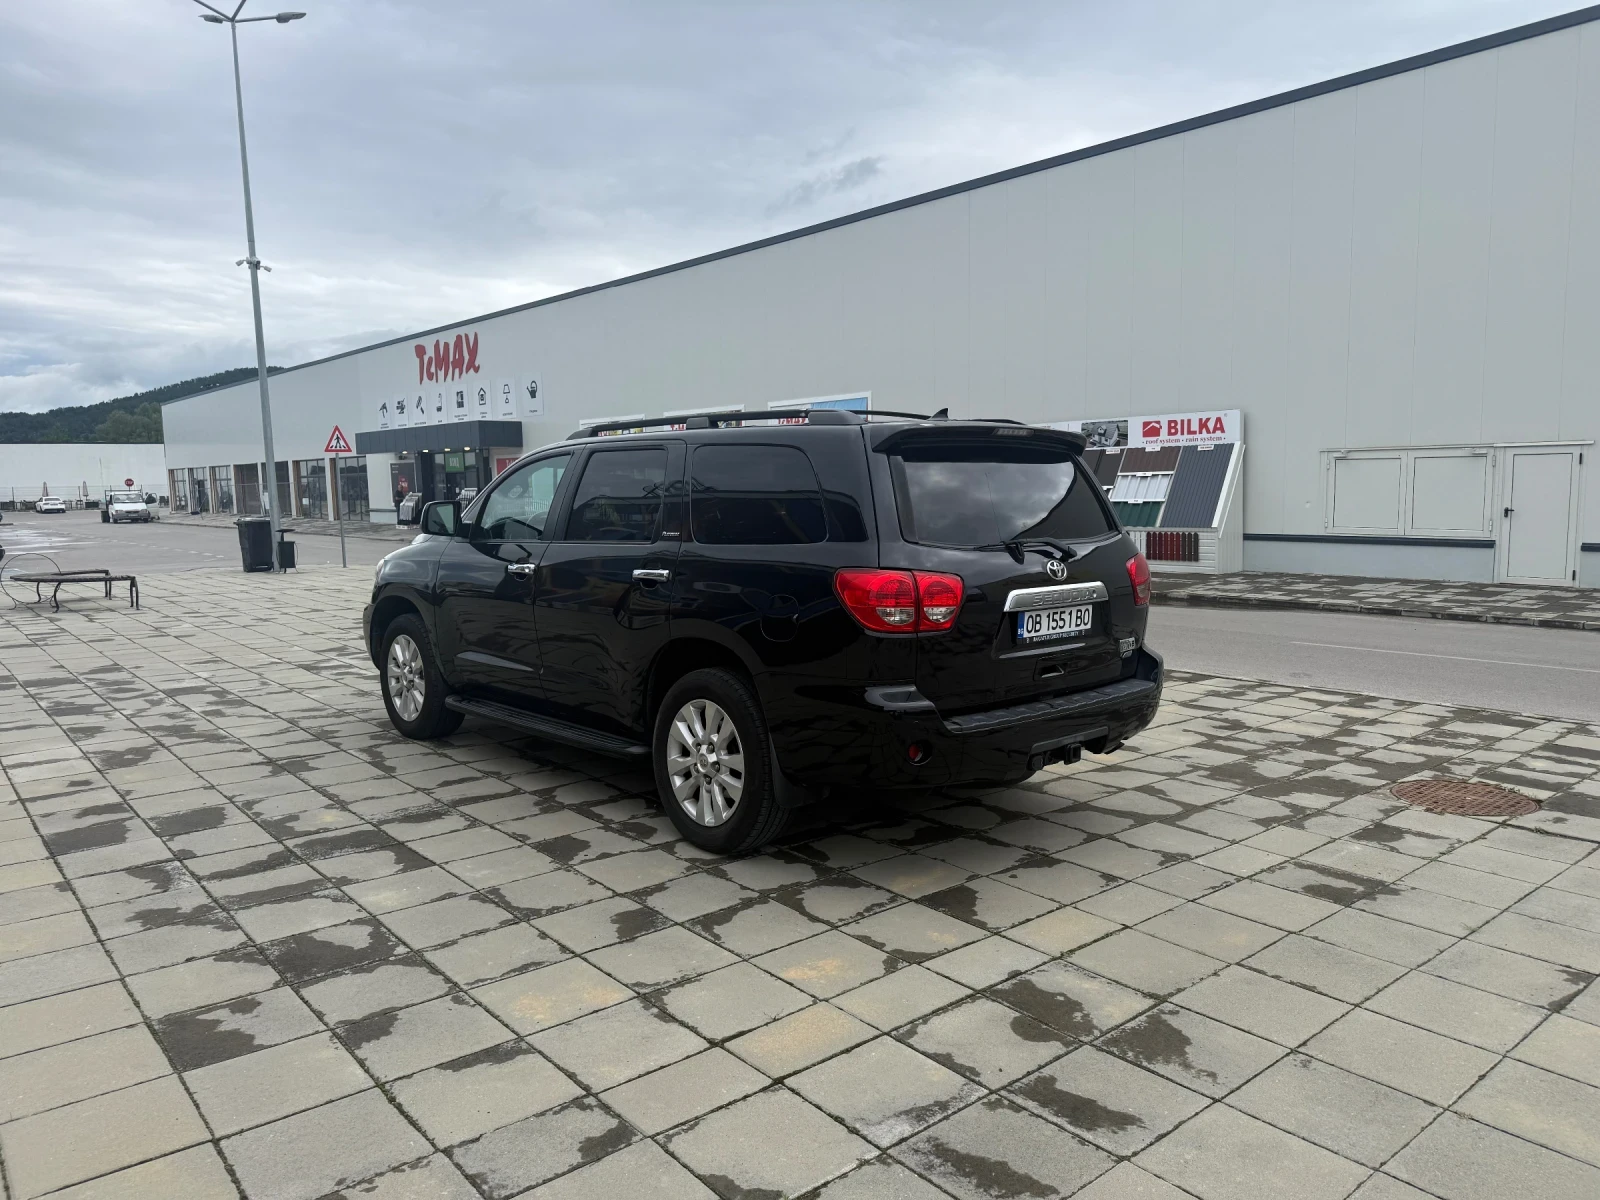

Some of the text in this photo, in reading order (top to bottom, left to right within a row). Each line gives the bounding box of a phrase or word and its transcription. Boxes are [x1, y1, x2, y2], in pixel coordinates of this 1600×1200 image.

[414, 331, 480, 385] TeMAX
[1167, 416, 1226, 436] BILKA
[1145, 437, 1159, 445] roof
[1159, 437, 1181, 445] system
[1199, 435, 1223, 444] system
[1032, 588, 1095, 606] SEQUOIA
[1026, 607, 1090, 634] OB 1551 BO
